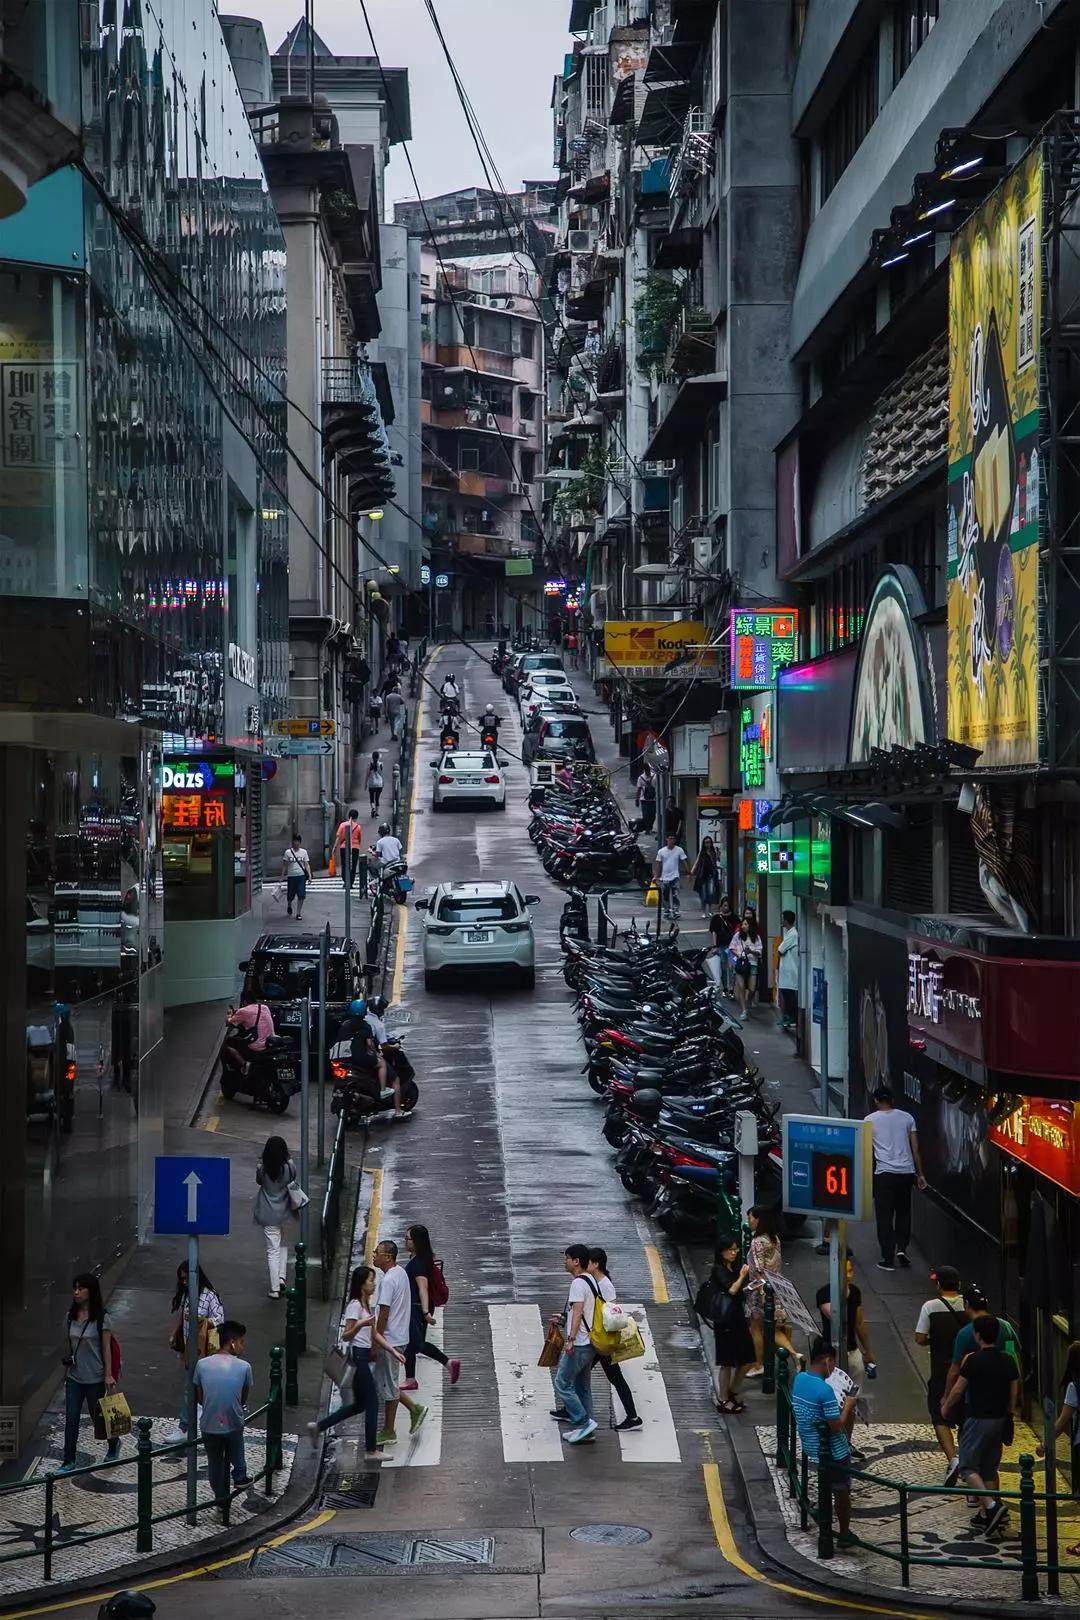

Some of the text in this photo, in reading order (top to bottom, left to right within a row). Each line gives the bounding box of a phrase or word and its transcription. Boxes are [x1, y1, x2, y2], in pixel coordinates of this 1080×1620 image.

[657, 638, 699, 650] Kodak
[162, 766, 204, 788] Dazs
[825, 1165, 848, 1196] 61
